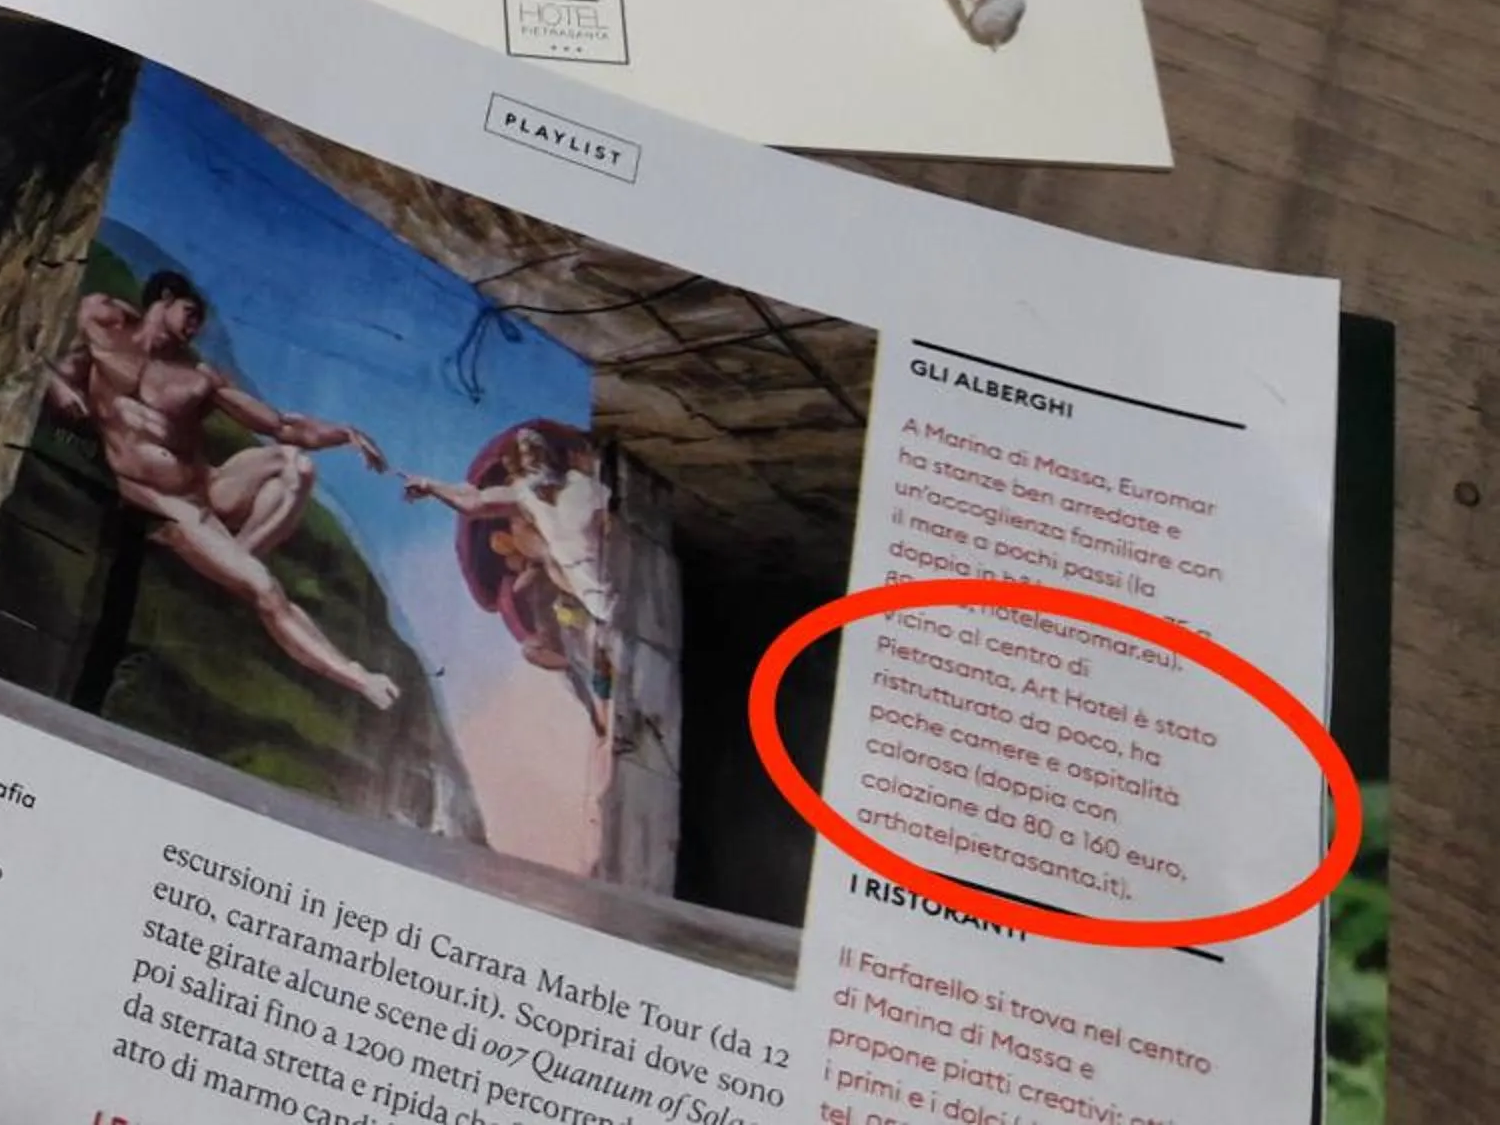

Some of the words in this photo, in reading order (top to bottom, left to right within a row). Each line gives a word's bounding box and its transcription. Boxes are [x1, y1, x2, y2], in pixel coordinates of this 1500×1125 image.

[519, 1, 610, 30] HOTEL
[504, 112, 623, 166] PLAYLIST
[909, 358, 949, 384] GLI
[953, 371, 1073, 418] ALBERGHI
[869, 704, 945, 738] poche
[949, 727, 1041, 767] camere
[1045, 755, 1061, 773] e
[1065, 761, 1180, 807] ospitalità
[872, 671, 1014, 724] ristrutturato
[1018, 712, 1051, 736] da
[1129, 740, 1162, 768] ha
[1020, 677, 1060, 704] Art
[1064, 687, 1128, 723] Hotel
[1132, 709, 1150, 729] è
[1154, 718, 1218, 748] stato
[860, 772, 981, 818] colazione
[983, 804, 1018, 829] da
[1022, 813, 1054, 840] 80
[1058, 829, 1076, 847] a
[1083, 830, 1121, 860] 160
[865, 737, 970, 780] calorosa
[974, 763, 1067, 809] (doppia
[1071, 798, 1118, 824] con
[152, 881, 216, 922] euro,
[225, 908, 505, 1020] carraramarbletour.it).
[514, 1001, 636, 1063] Scoprirai
[644, 1043, 709, 1085] dove
[716, 1072, 785, 1108] sono
[162, 843, 293, 906] escursioni
[299, 887, 326, 918] in
[332, 900, 389, 942] jeep
[395, 922, 423, 951] di
[429, 933, 526, 987] Carrara
[536, 967, 631, 1020] Marble
[639, 999, 703, 1042] Tour
[709, 1024, 752, 1059] (da
[762, 1044, 790, 1069] 12
[142, 919, 204, 956] state
[204, 942, 281, 984] girate
[283, 967, 371, 1015] alcune
[373, 1001, 448, 1041] scene
[451, 1022, 478, 1051] di
[480, 1038, 530, 1068] 007
[530, 1049, 653, 1108] Quantum
[656, 1093, 691, 1122] of
